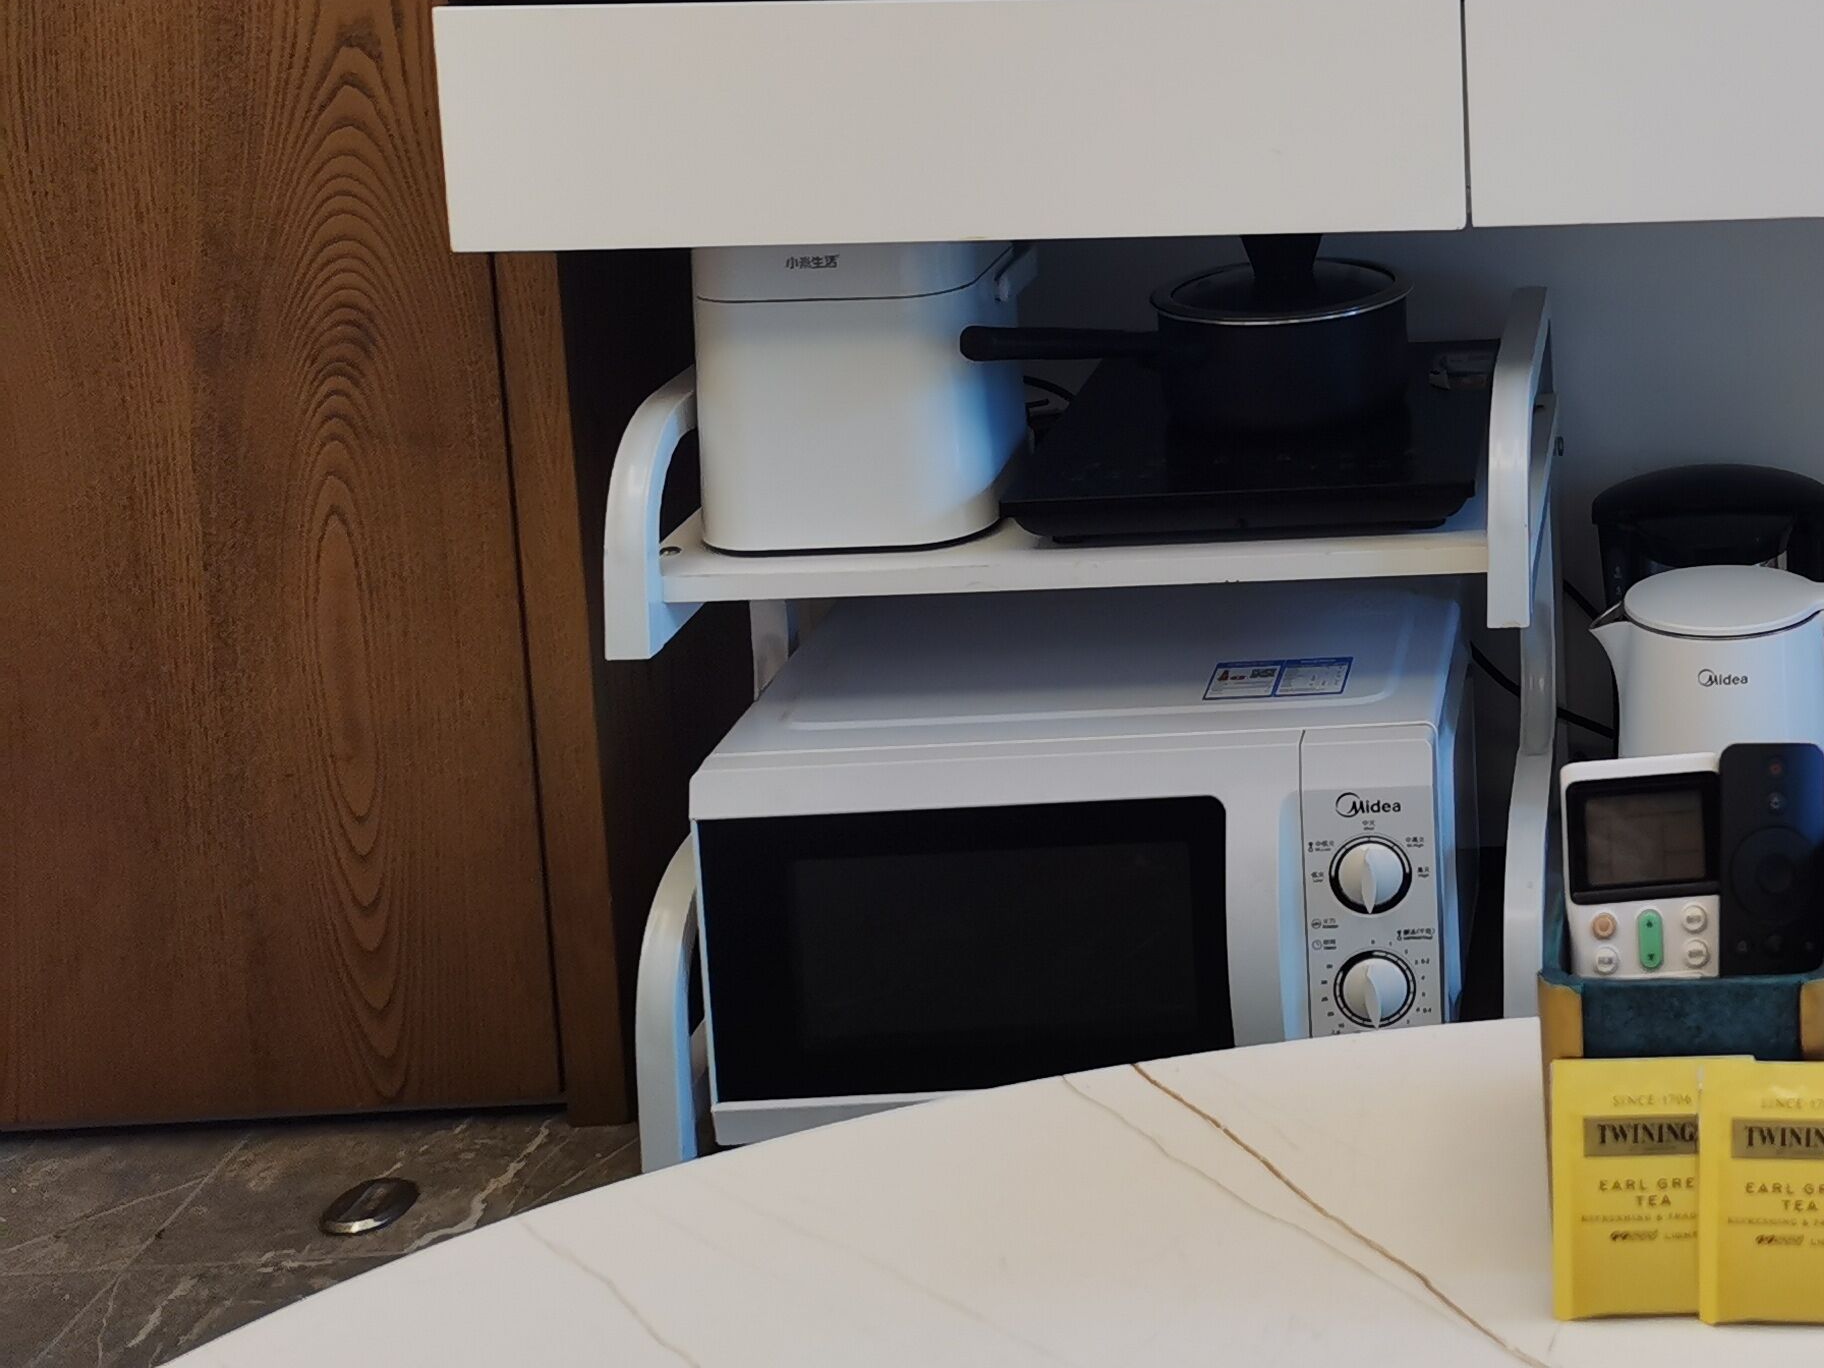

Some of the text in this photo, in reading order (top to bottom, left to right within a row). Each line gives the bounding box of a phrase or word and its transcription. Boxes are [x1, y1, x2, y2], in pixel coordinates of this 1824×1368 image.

[1697, 668, 1749, 688] Midea
[1335, 791, 1402, 818] Midea
[1598, 1176, 1696, 1192] EARL GRE
[1745, 1182, 1796, 1196] EARL
[1635, 1194, 1672, 1208] TEA
[1780, 1198, 1819, 1212] TEA
